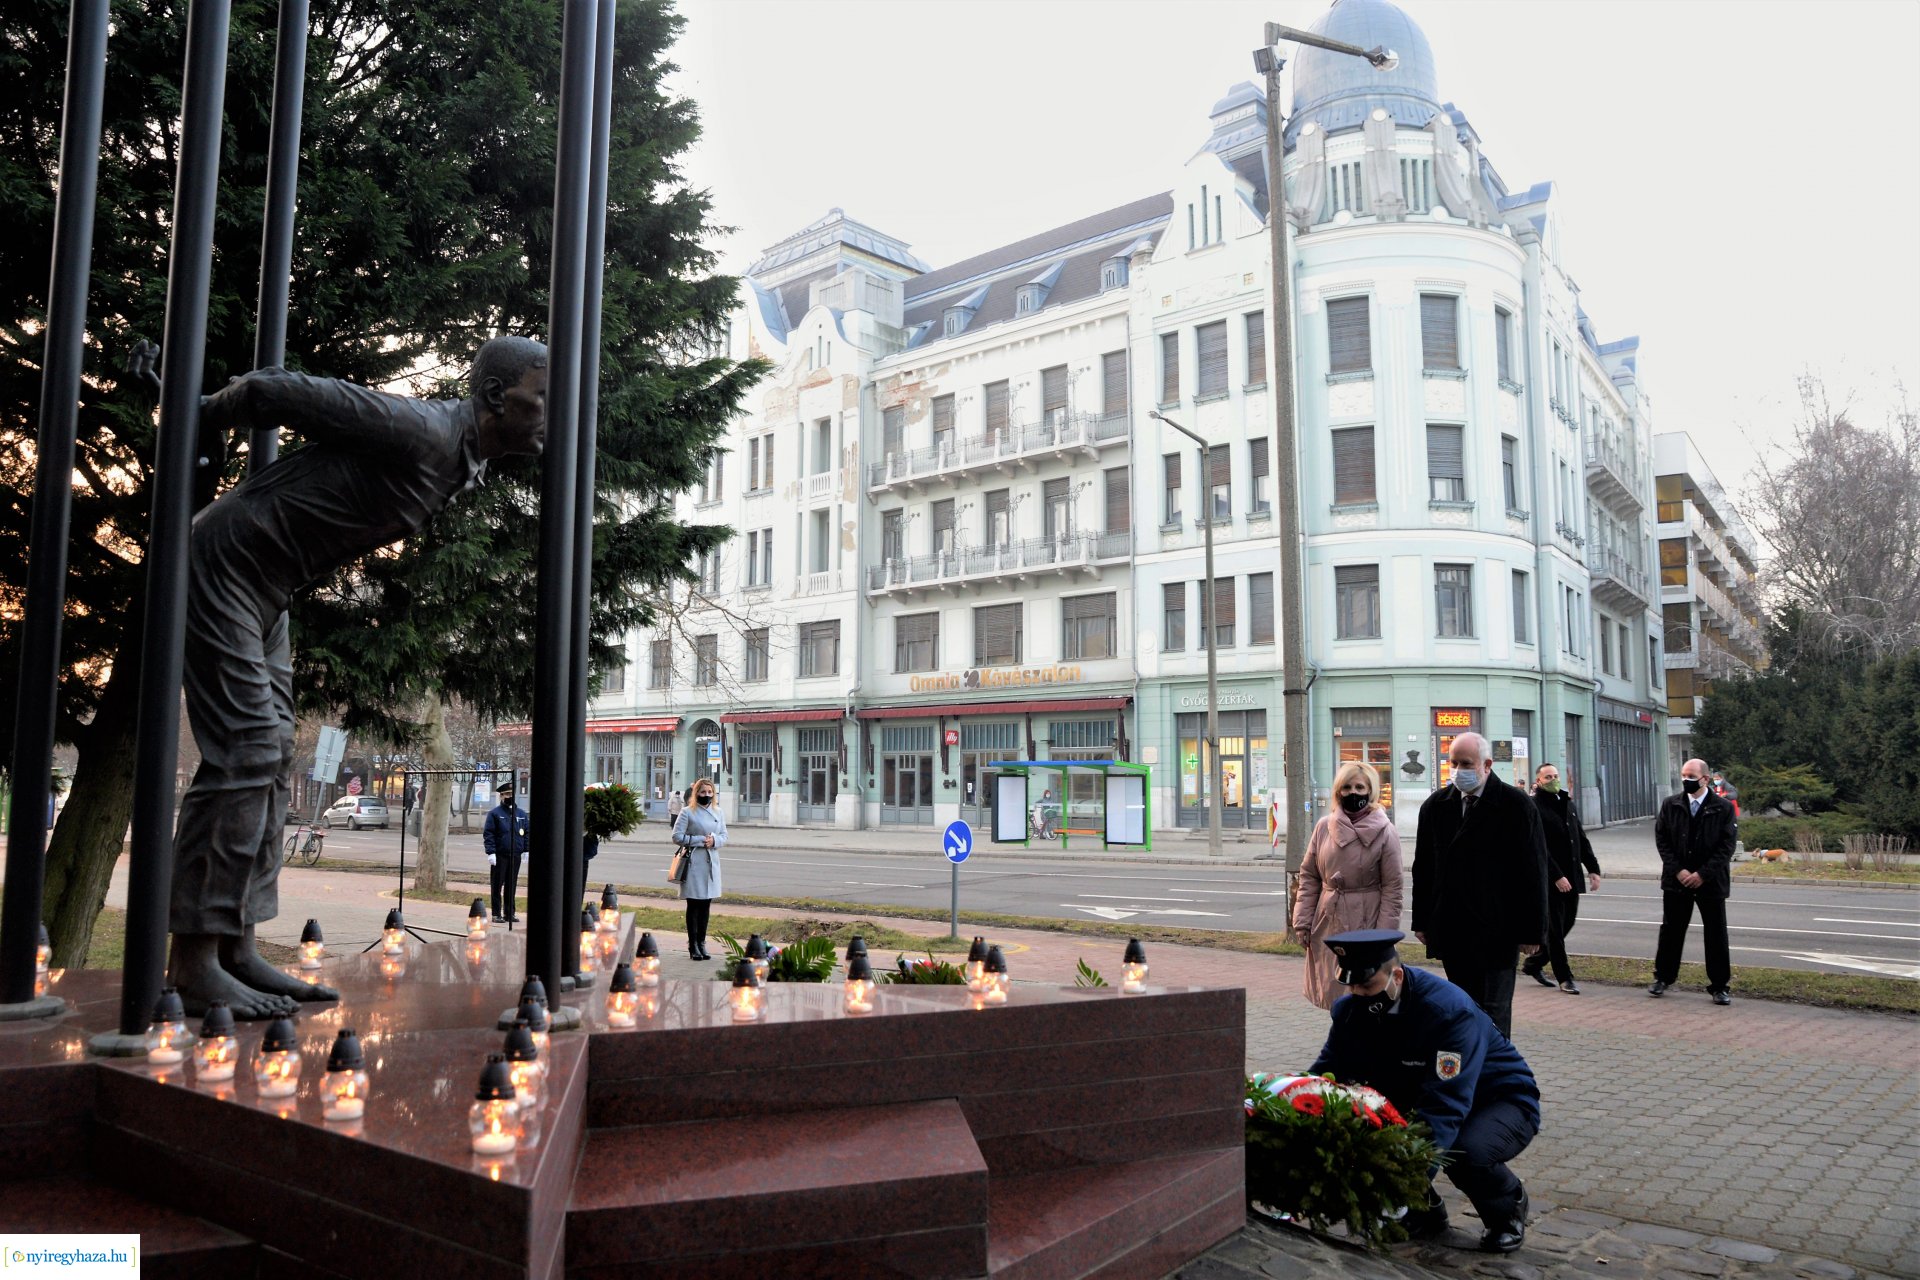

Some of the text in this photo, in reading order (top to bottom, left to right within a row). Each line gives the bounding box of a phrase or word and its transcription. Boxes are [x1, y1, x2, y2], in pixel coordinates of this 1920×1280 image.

[910, 663, 1081, 692] Omnia Kávészalon
[1181, 693, 1256, 706] GYÓGZERTÁR
[1439, 714, 1469, 725] PÉKSÉG
[947, 732, 958, 744] illy
